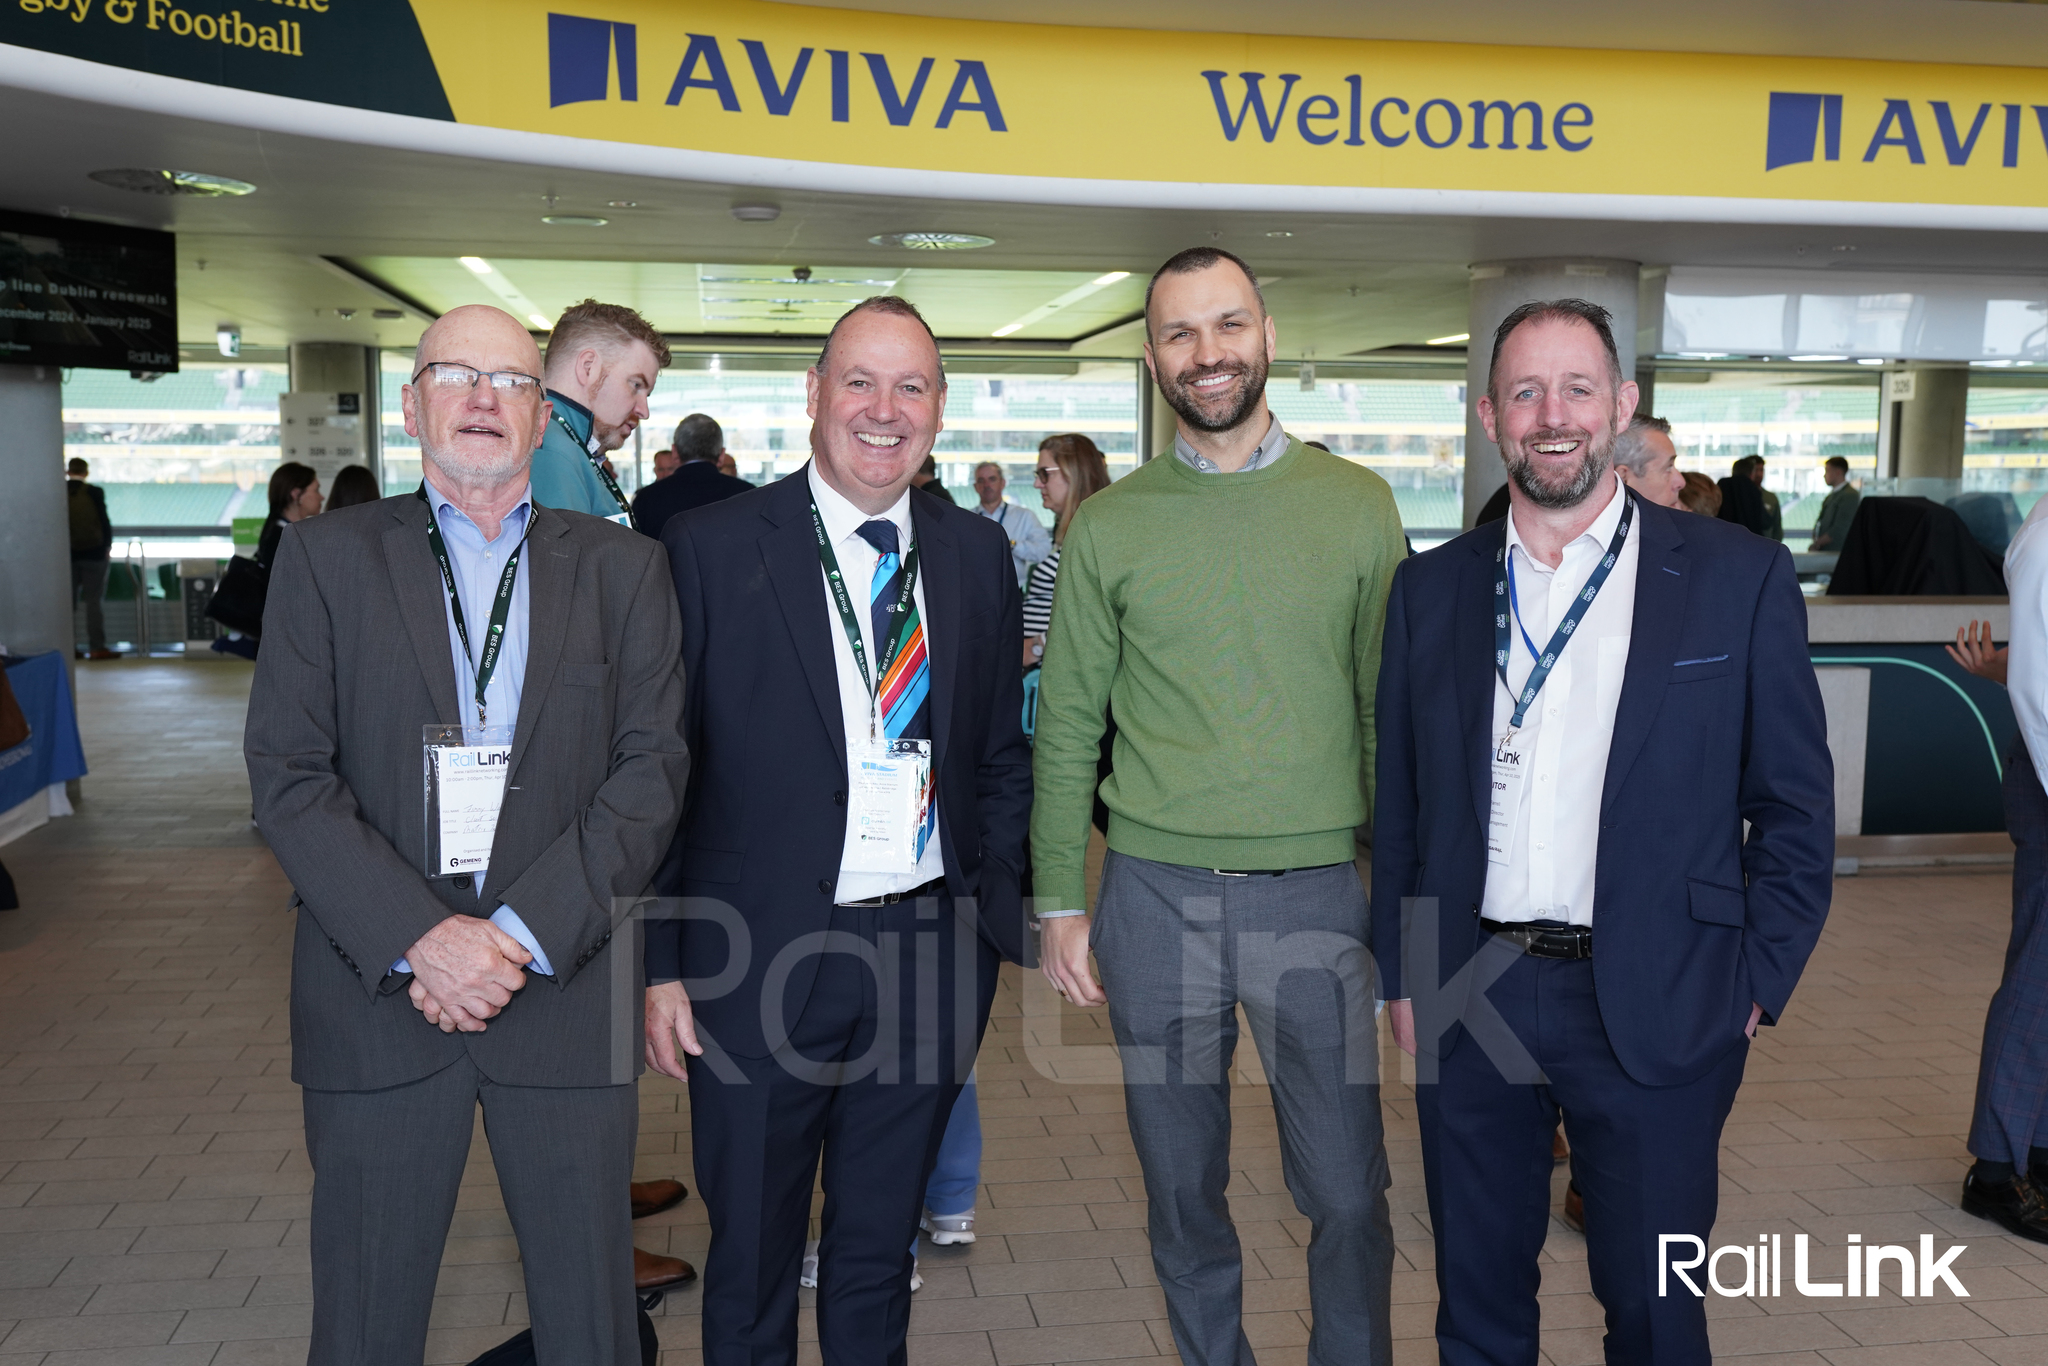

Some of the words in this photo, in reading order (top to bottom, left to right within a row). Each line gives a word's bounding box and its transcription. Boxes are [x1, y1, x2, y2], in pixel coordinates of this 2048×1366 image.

[146, 0, 303, 56] Football
[664, 32, 1009, 132] AVIVA
[1200, 70, 1594, 152] Welcome
[1862, 98, 2048, 168] AVI
[12, 278, 43, 293] line
[48, 282, 97, 299] Dublin
[102, 290, 168, 305] renewals
[0, 307, 45, 320] ecember
[48, 310, 74, 322] 2024
[83, 313, 125, 330] January
[127, 317, 151, 330] 2025
[815, 526, 825, 546] Group
[500, 579, 511, 598] Group
[834, 581, 843, 593] BES
[904, 572, 913, 590] Group
[838, 593, 849, 614] Group
[490, 634, 498, 647] BES
[484, 647, 495, 668] Group
[881, 657, 889, 670] BES
[886, 638, 895, 658] Group
[861, 664, 869, 685] Group
